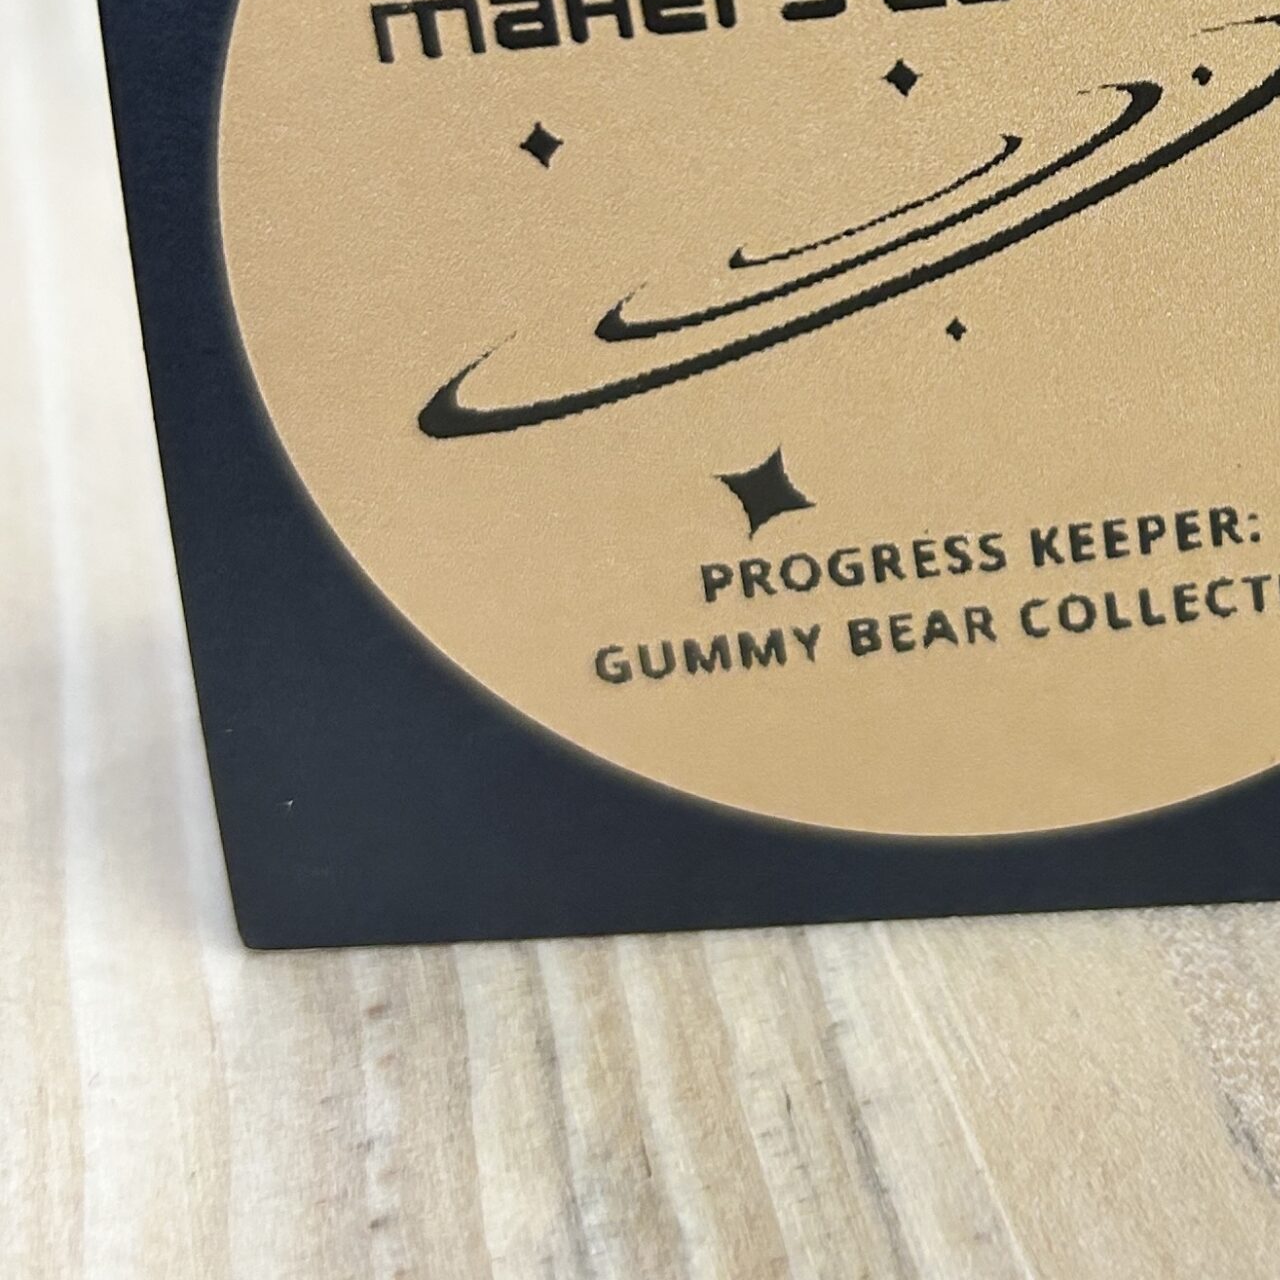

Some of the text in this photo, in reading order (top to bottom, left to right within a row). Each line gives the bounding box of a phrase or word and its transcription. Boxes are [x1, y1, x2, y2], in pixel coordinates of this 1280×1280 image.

[698, 505, 1263, 606] PROGRESS KEEPER:
[592, 623, 823, 687] GUMMY
[845, 605, 999, 659] BEAR
